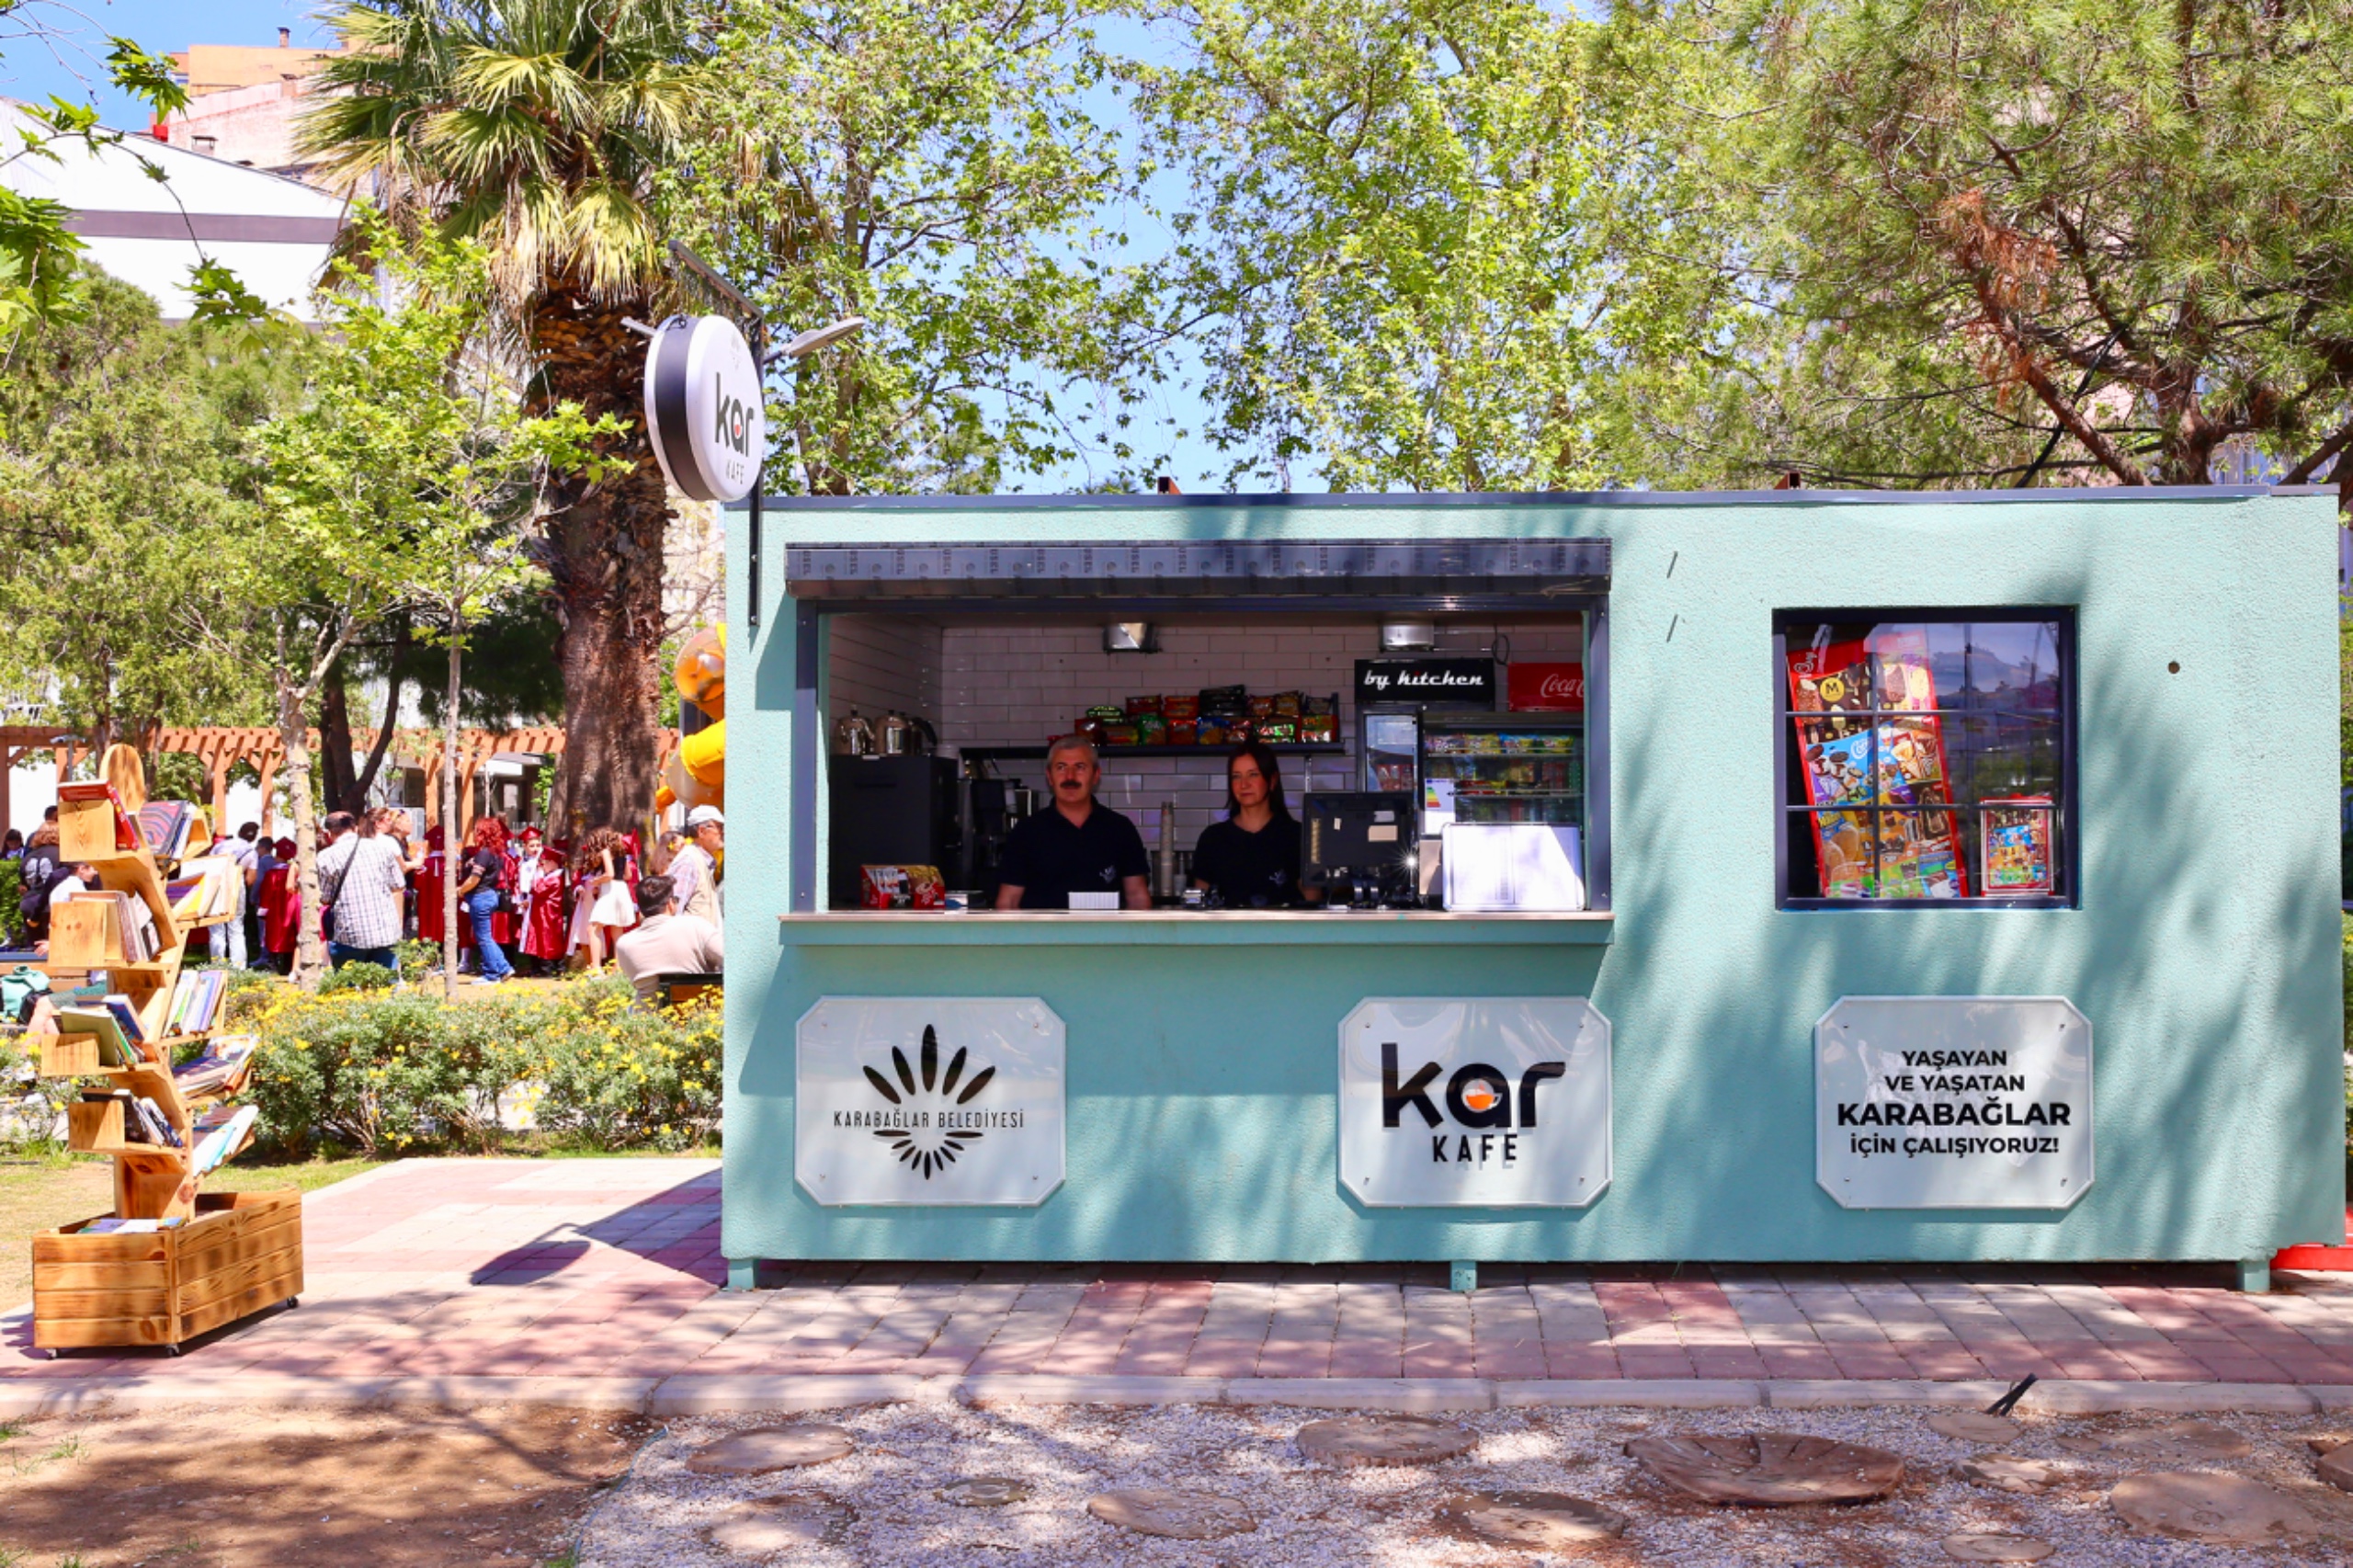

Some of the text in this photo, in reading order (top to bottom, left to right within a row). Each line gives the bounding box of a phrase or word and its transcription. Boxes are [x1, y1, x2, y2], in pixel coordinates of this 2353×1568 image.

[715, 371, 755, 457] kar
[1364, 670, 1484, 690] by kitchen
[1901, 1051, 2007, 1071] YAŞAYAN
[1381, 1042, 1565, 1129] kar
[1885, 1075, 2025, 1095] VE YAŞATAN
[834, 1108, 1024, 1128] KARABAĞLAR BELEDİYESİ
[1838, 1096, 2071, 1126] KARABAĞLAR
[1432, 1134, 1518, 1162] KAFE
[1850, 1133, 2059, 1158] İÇİN ÇALIŞIYORUZ!
